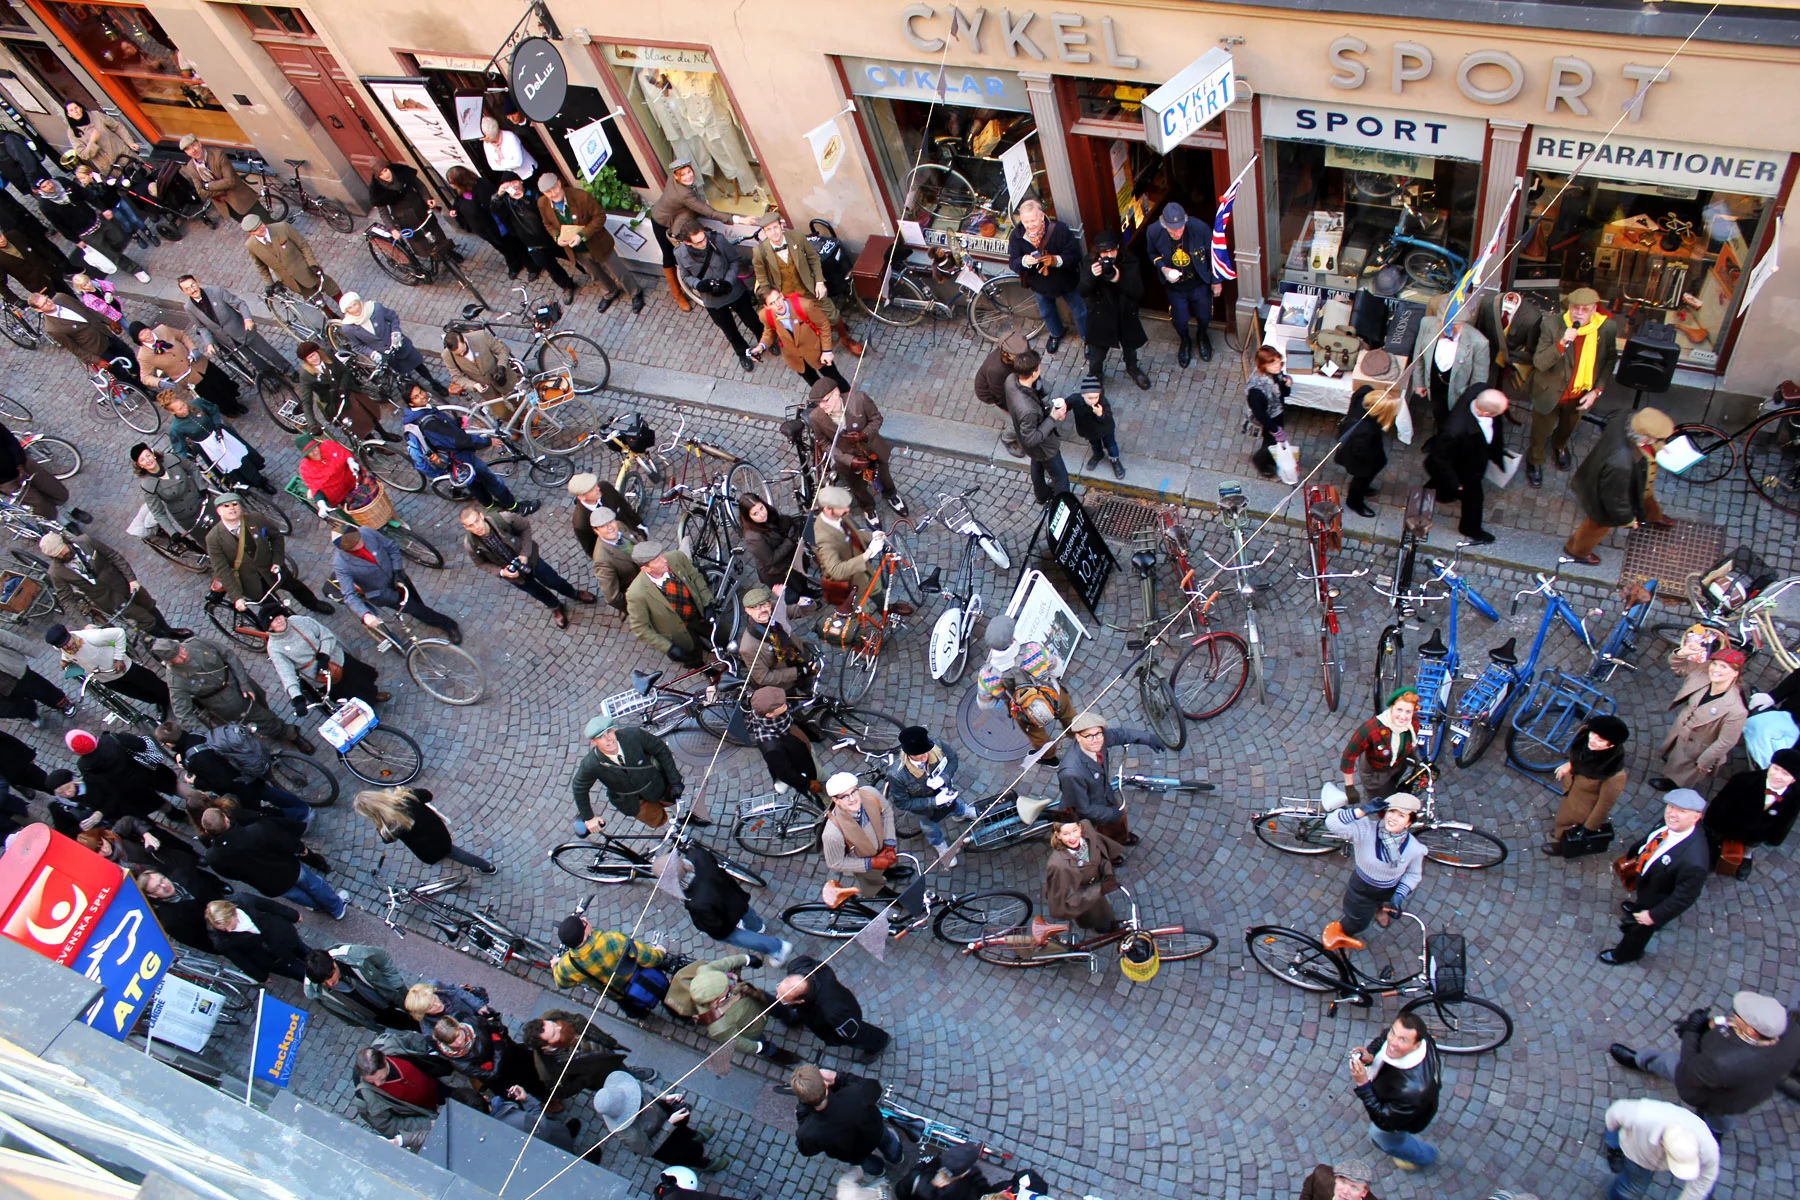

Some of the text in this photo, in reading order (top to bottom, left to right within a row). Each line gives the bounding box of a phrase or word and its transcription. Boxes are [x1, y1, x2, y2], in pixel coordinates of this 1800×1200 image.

[900, 4, 1138, 69] CYKEL
[524, 62, 555, 100] DeLuz
[1178, 71, 1231, 138] SPORT
[1329, 36, 1671, 122] SPORT
[1163, 78, 1215, 137] CYKEL
[1296, 109, 1447, 145] SPORT
[1537, 137, 1778, 182] REPARATIONER
[1391, 309, 1412, 344] BROOKS
[1050, 501, 1065, 532] TWEED
[1078, 560, 1092, 584] 10
[943, 621, 958, 659] SvD
[56, 886, 110, 965] SVENSKA SPEL
[113, 951, 162, 1033] ATG
[268, 1013, 301, 1078] Jackpot
